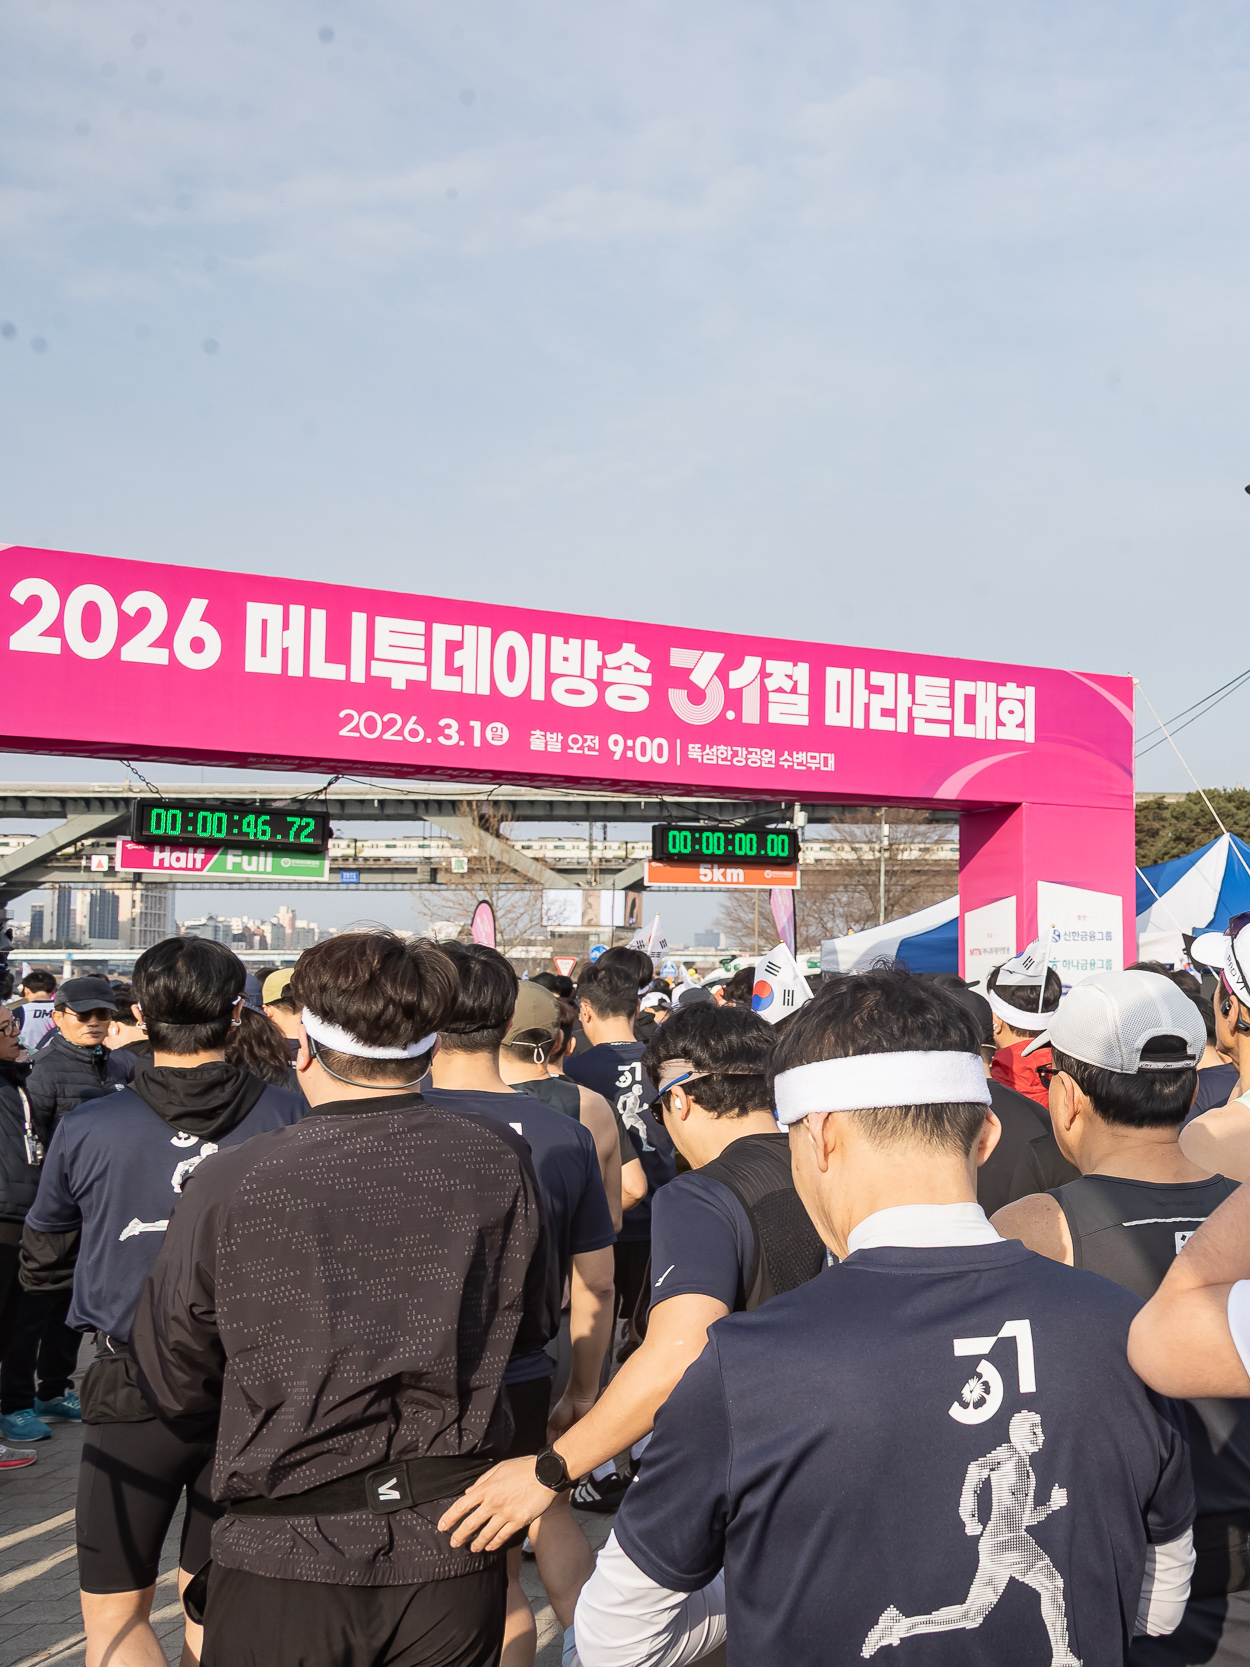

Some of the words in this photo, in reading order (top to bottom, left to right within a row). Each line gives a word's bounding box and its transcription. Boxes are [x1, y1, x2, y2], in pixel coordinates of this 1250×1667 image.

[9, 577, 222, 671] 2026
[244, 601, 652, 713] 머니투데이방송
[668, 646, 809, 726] 3.1절
[824, 665, 1036, 744] 마라톤대회
[529, 729, 563, 753] 출발
[566, 734, 600, 756] 오전
[607, 733, 669, 764] 9:00
[687, 744, 776, 769] 뚝섬한강공원
[778, 750, 835, 772] 수변무대
[150, 808, 315, 843] 00:00:46.72
[668, 830, 789, 857] 00:00:00.00
[152, 846, 205, 869] Half
[226, 849, 273, 872] Full
[699, 864, 744, 883] 5km
[1063, 931, 1113, 942] 신한금융그룹
[1062, 959, 1113, 971] 하나금융그룹
